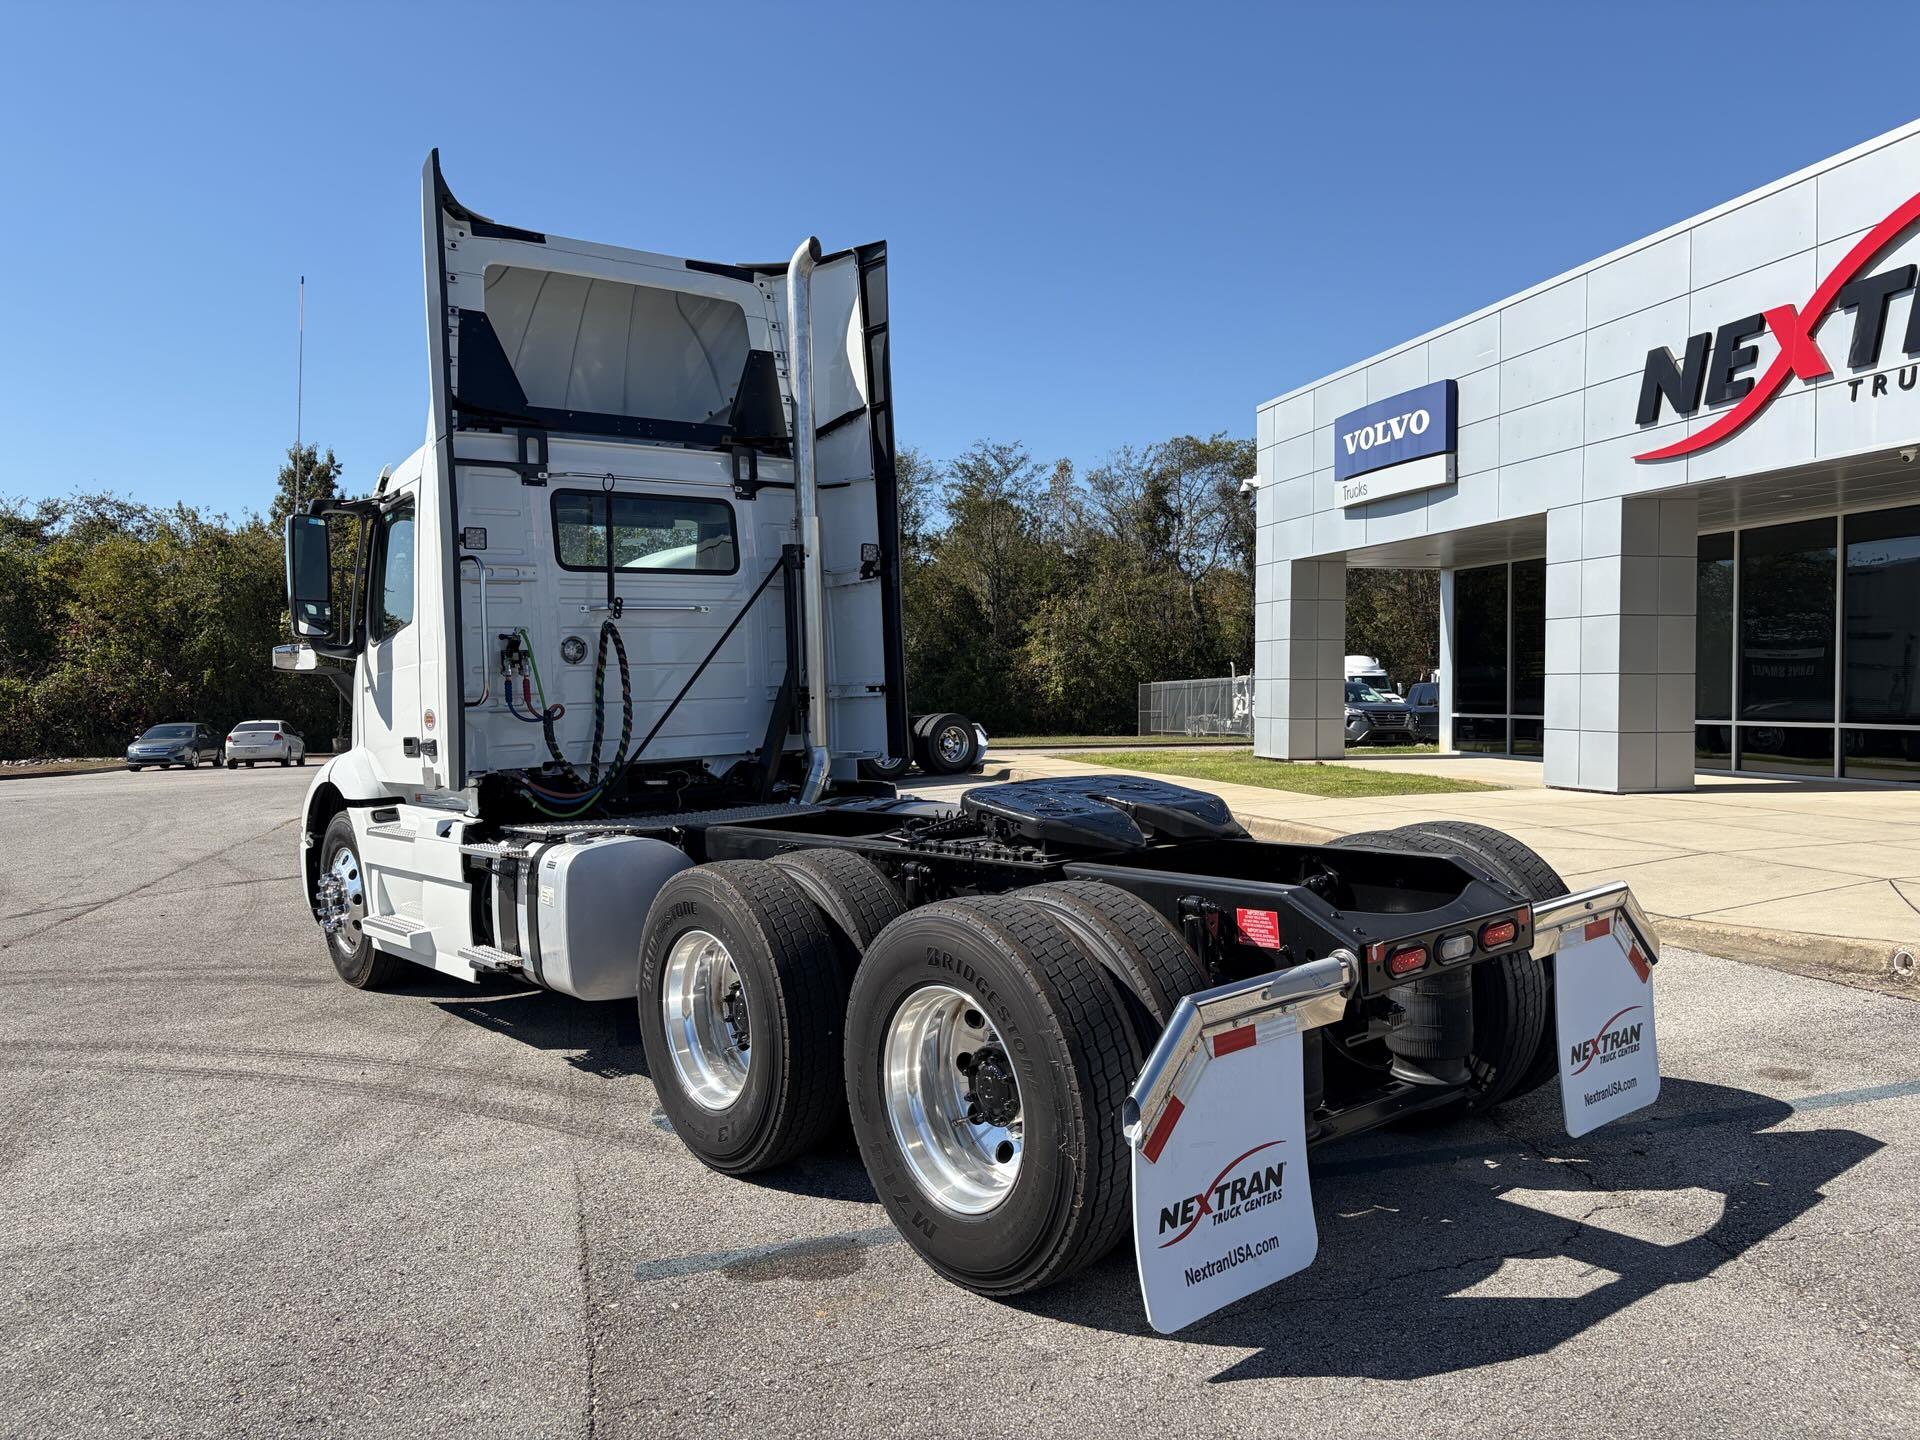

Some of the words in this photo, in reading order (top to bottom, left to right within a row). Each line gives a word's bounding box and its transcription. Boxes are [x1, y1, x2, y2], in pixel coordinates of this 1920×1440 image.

[1847, 365, 1919, 403] TRU
[1342, 409, 1430, 455] VOLVO
[1342, 481, 1368, 501] Trucks
[1570, 1022, 1643, 1066] NEXTRAN
[1599, 1050, 1617, 1064] TRUCK
[1617, 1042, 1640, 1058] CENTERS
[1584, 1077, 1638, 1107] NextranUSA.com
[1158, 1161, 1286, 1235] NEXTRAN
[1212, 1204, 1242, 1226] TRUCK
[1244, 1188, 1283, 1213] CENTERS
[1184, 1235, 1280, 1287] NextranUSA.com
